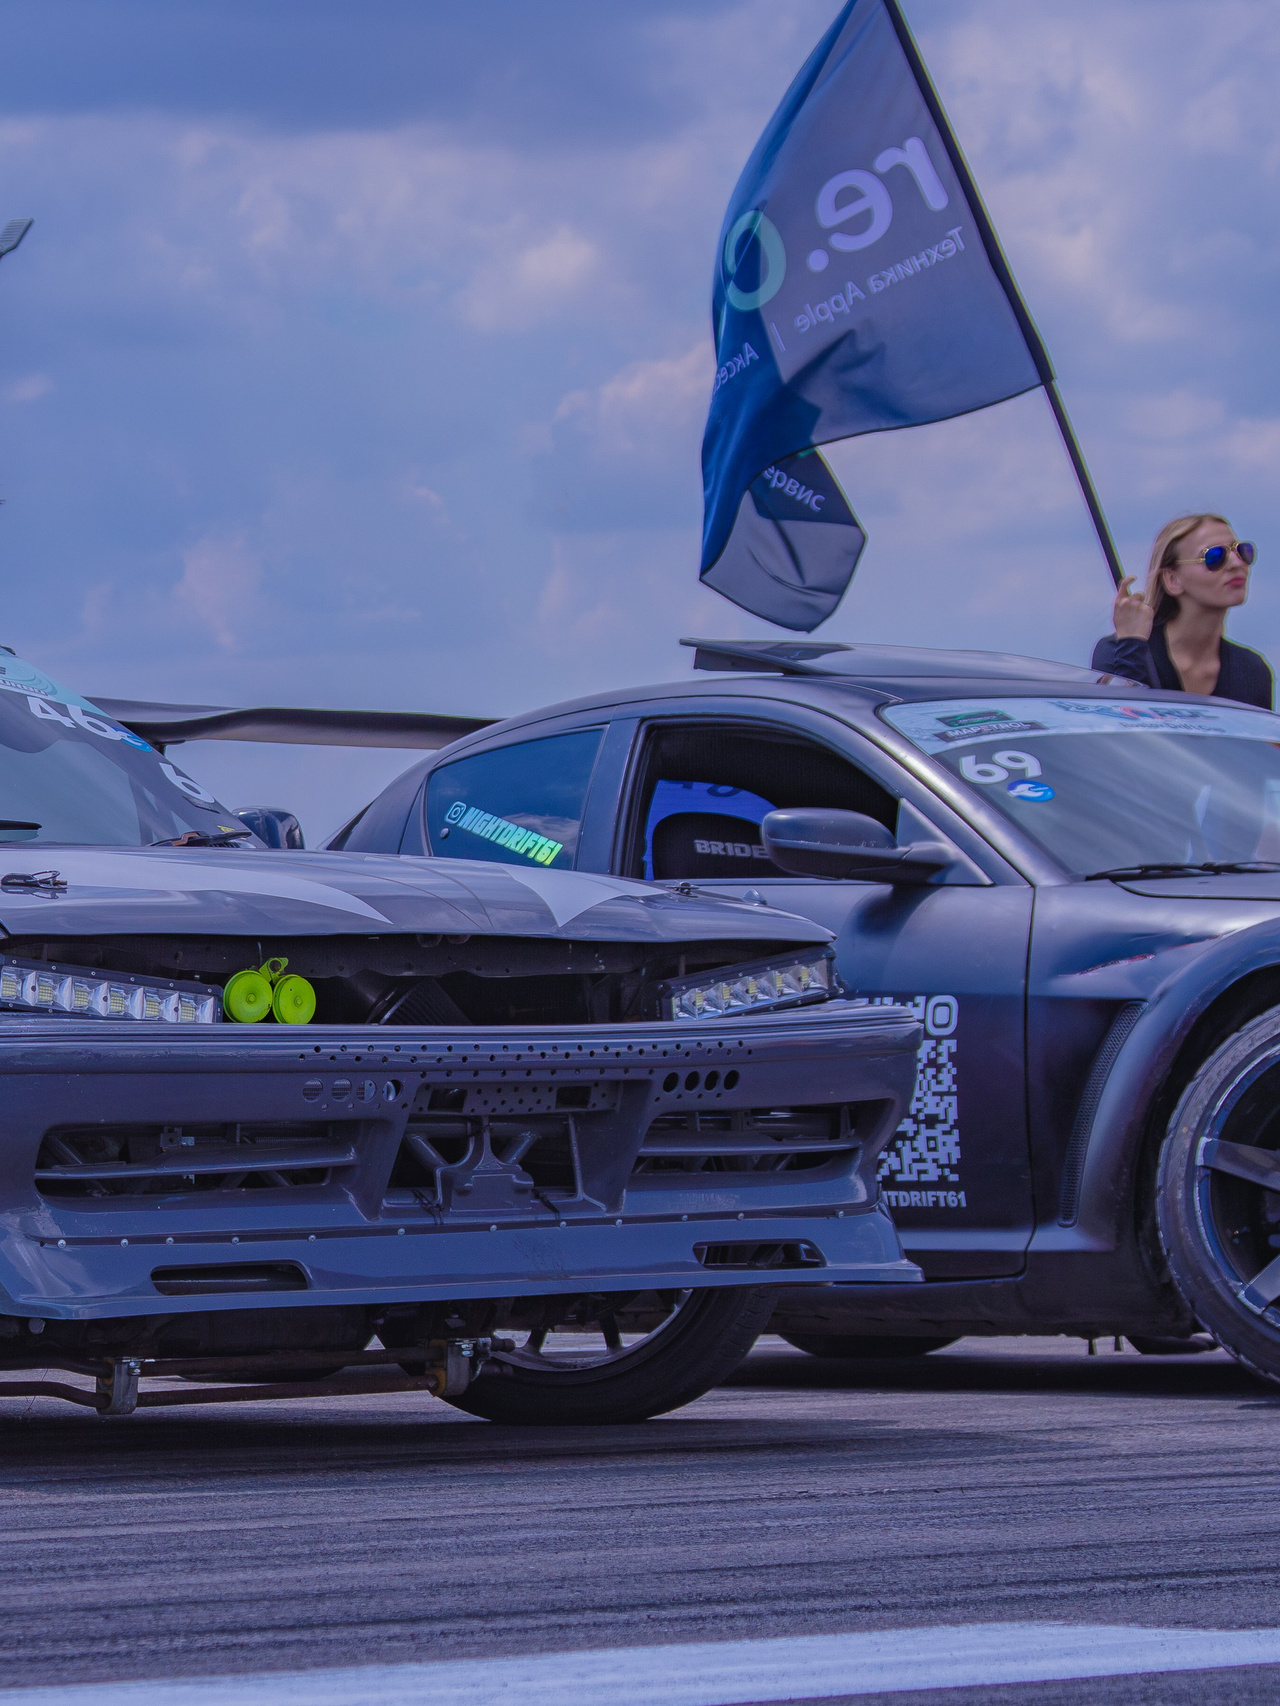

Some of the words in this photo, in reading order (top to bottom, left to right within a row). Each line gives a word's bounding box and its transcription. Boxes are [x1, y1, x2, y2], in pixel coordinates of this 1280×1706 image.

[27, 696, 121, 740] 46
[946, 721, 1031, 737] MAPETROL
[959, 750, 1042, 785] 69
[457, 806, 563, 866] NIGHTDRIFT61
[694, 839, 770, 859] BRIDE
